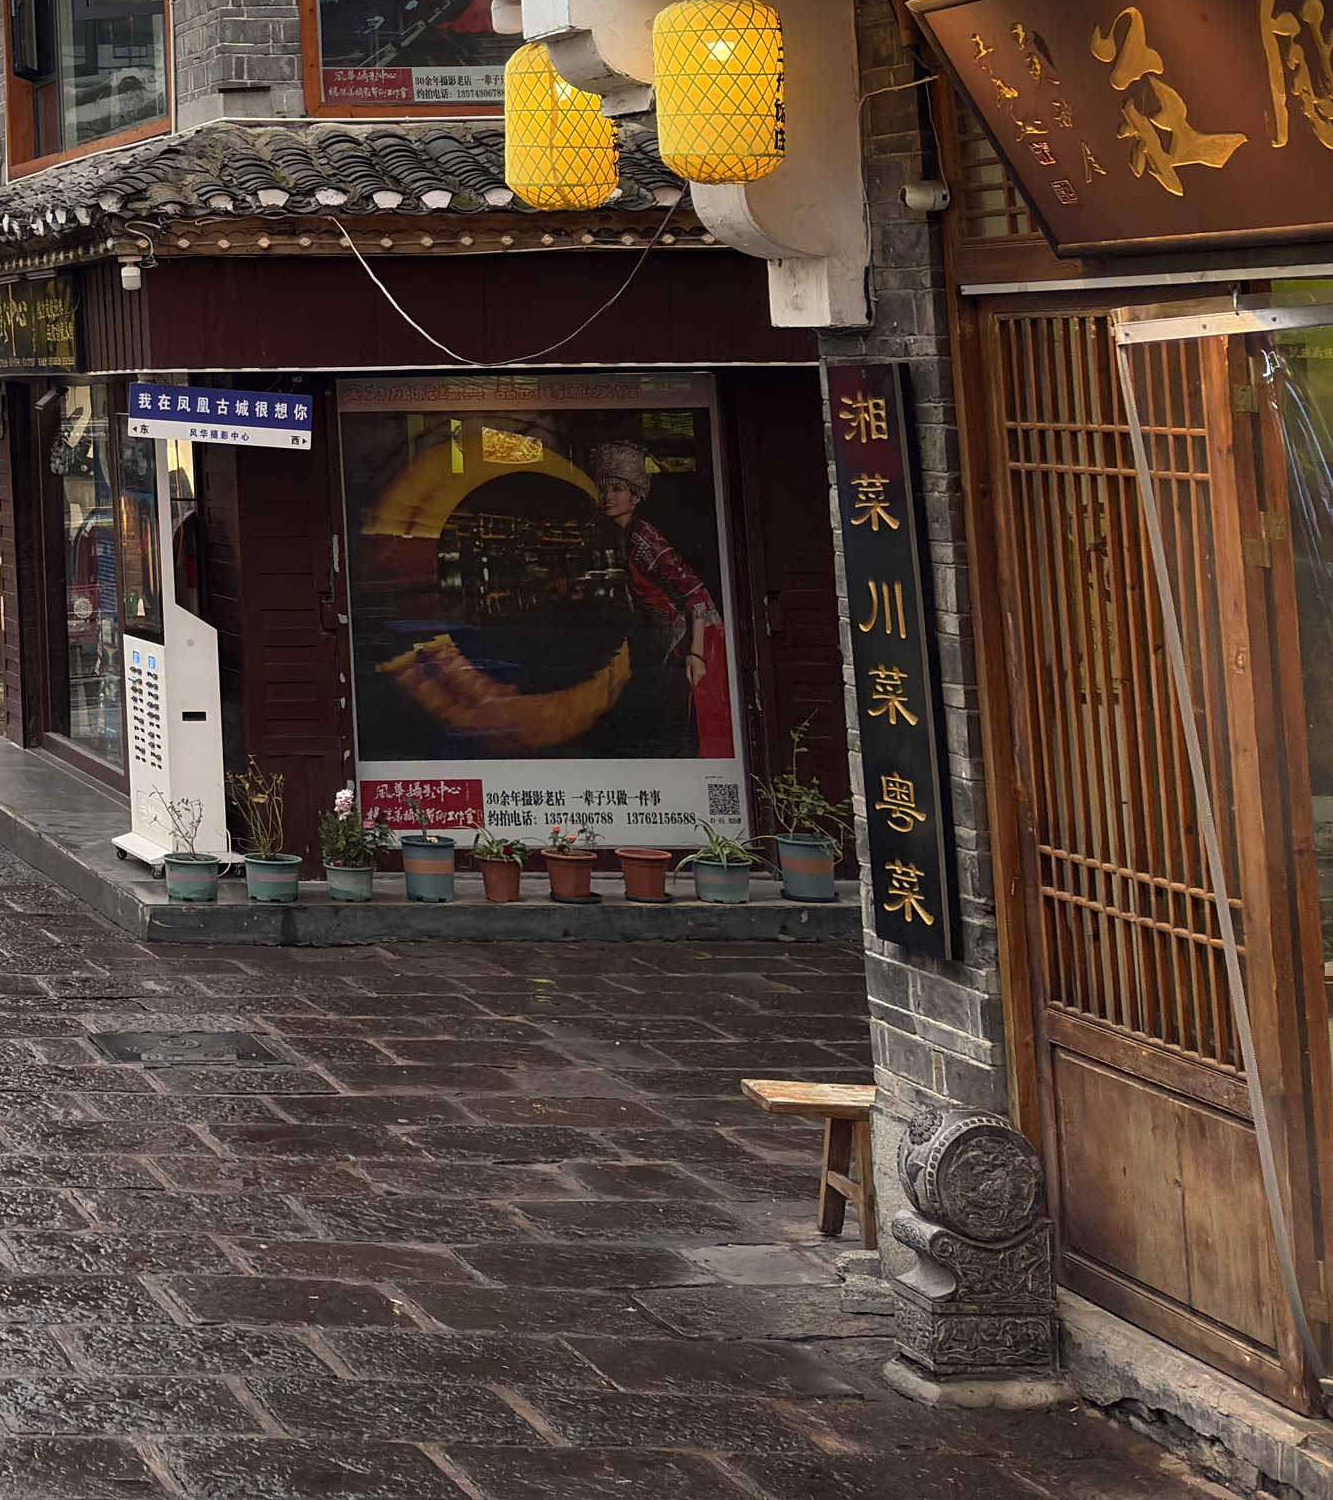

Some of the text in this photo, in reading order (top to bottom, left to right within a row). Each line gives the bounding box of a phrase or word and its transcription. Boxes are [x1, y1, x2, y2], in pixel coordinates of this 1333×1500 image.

[415, 75, 472, 87] 30余年摄影老店
[138, 392, 308, 421] 我在凤凰古城很想你
[140, 424, 149, 435] 东
[189, 428, 250, 442] 风华摄影中心
[291, 435, 300, 445] 西
[839, 389, 935, 926] 湘菜川菜粤菜
[486, 789, 661, 807] 30余年摄影老店 一辈子只做一件事
[544, 812, 614, 826] 13574306788
[626, 812, 696, 826] 13762156588
